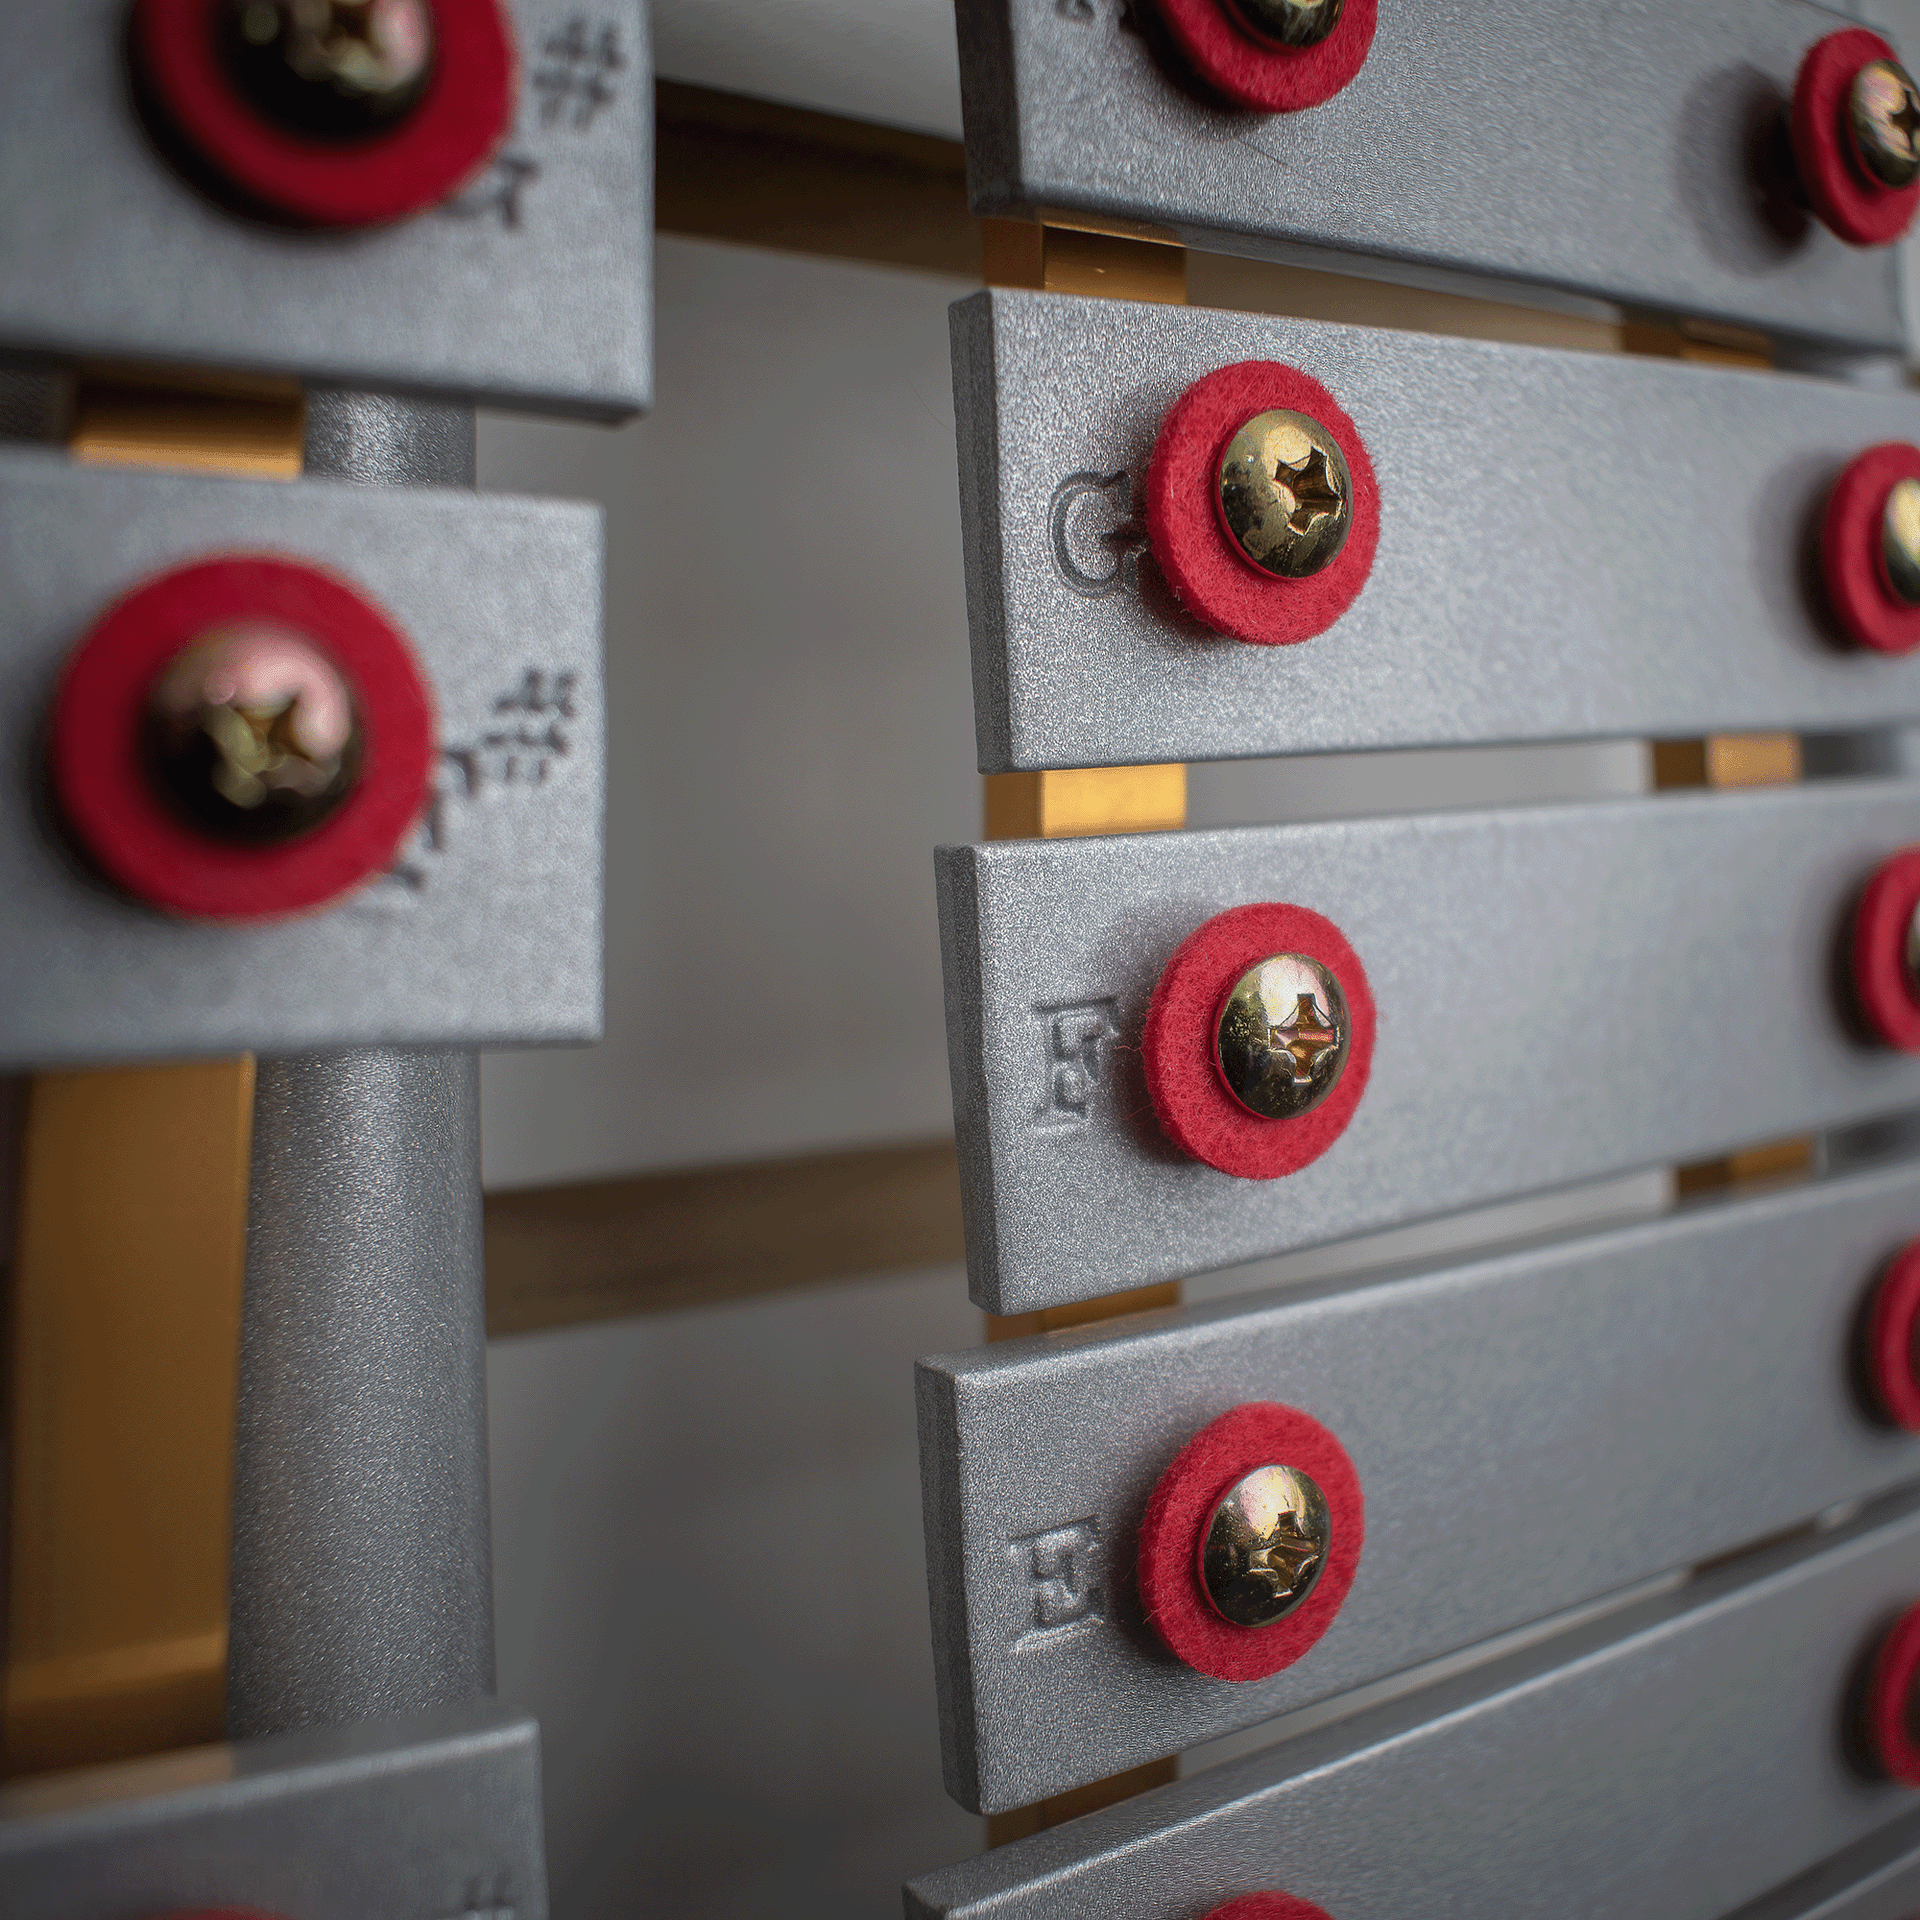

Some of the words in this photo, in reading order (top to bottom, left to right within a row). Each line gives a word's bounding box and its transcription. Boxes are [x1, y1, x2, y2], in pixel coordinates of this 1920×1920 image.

[1047, 470, 1149, 599] G
[1032, 996, 1122, 1132] F
[1009, 1513, 1104, 1652] E
